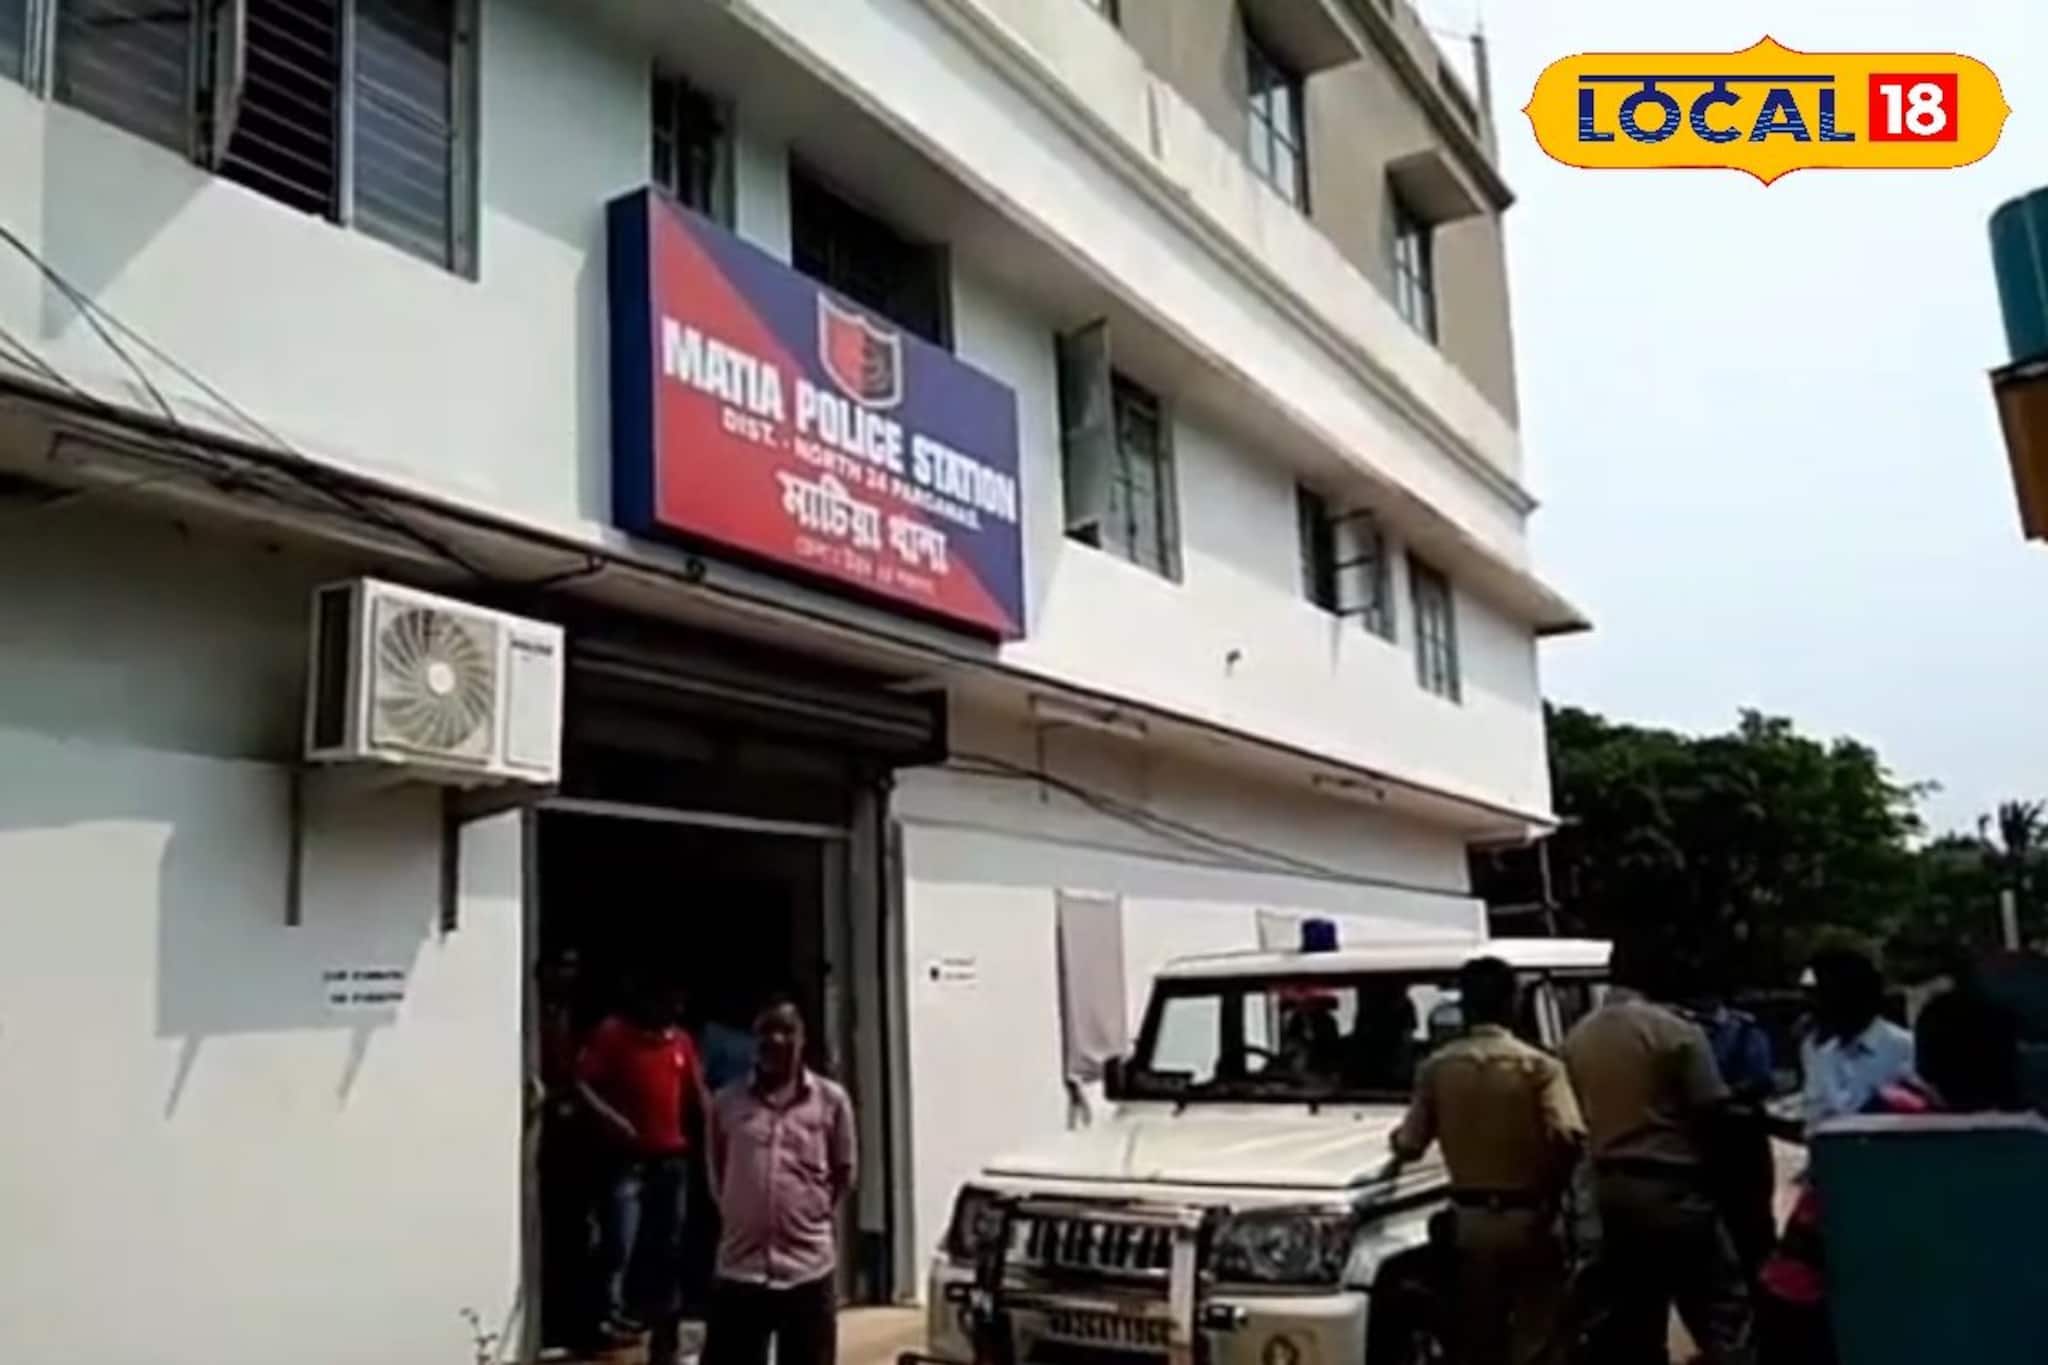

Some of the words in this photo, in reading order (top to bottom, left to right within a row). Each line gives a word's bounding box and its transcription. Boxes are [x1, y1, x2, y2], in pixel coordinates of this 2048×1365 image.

[662, 315, 785, 423] MATIA
[796, 377, 904, 475] POLICE
[911, 432, 1017, 524] STATION
[794, 434, 862, 483] NORTH
